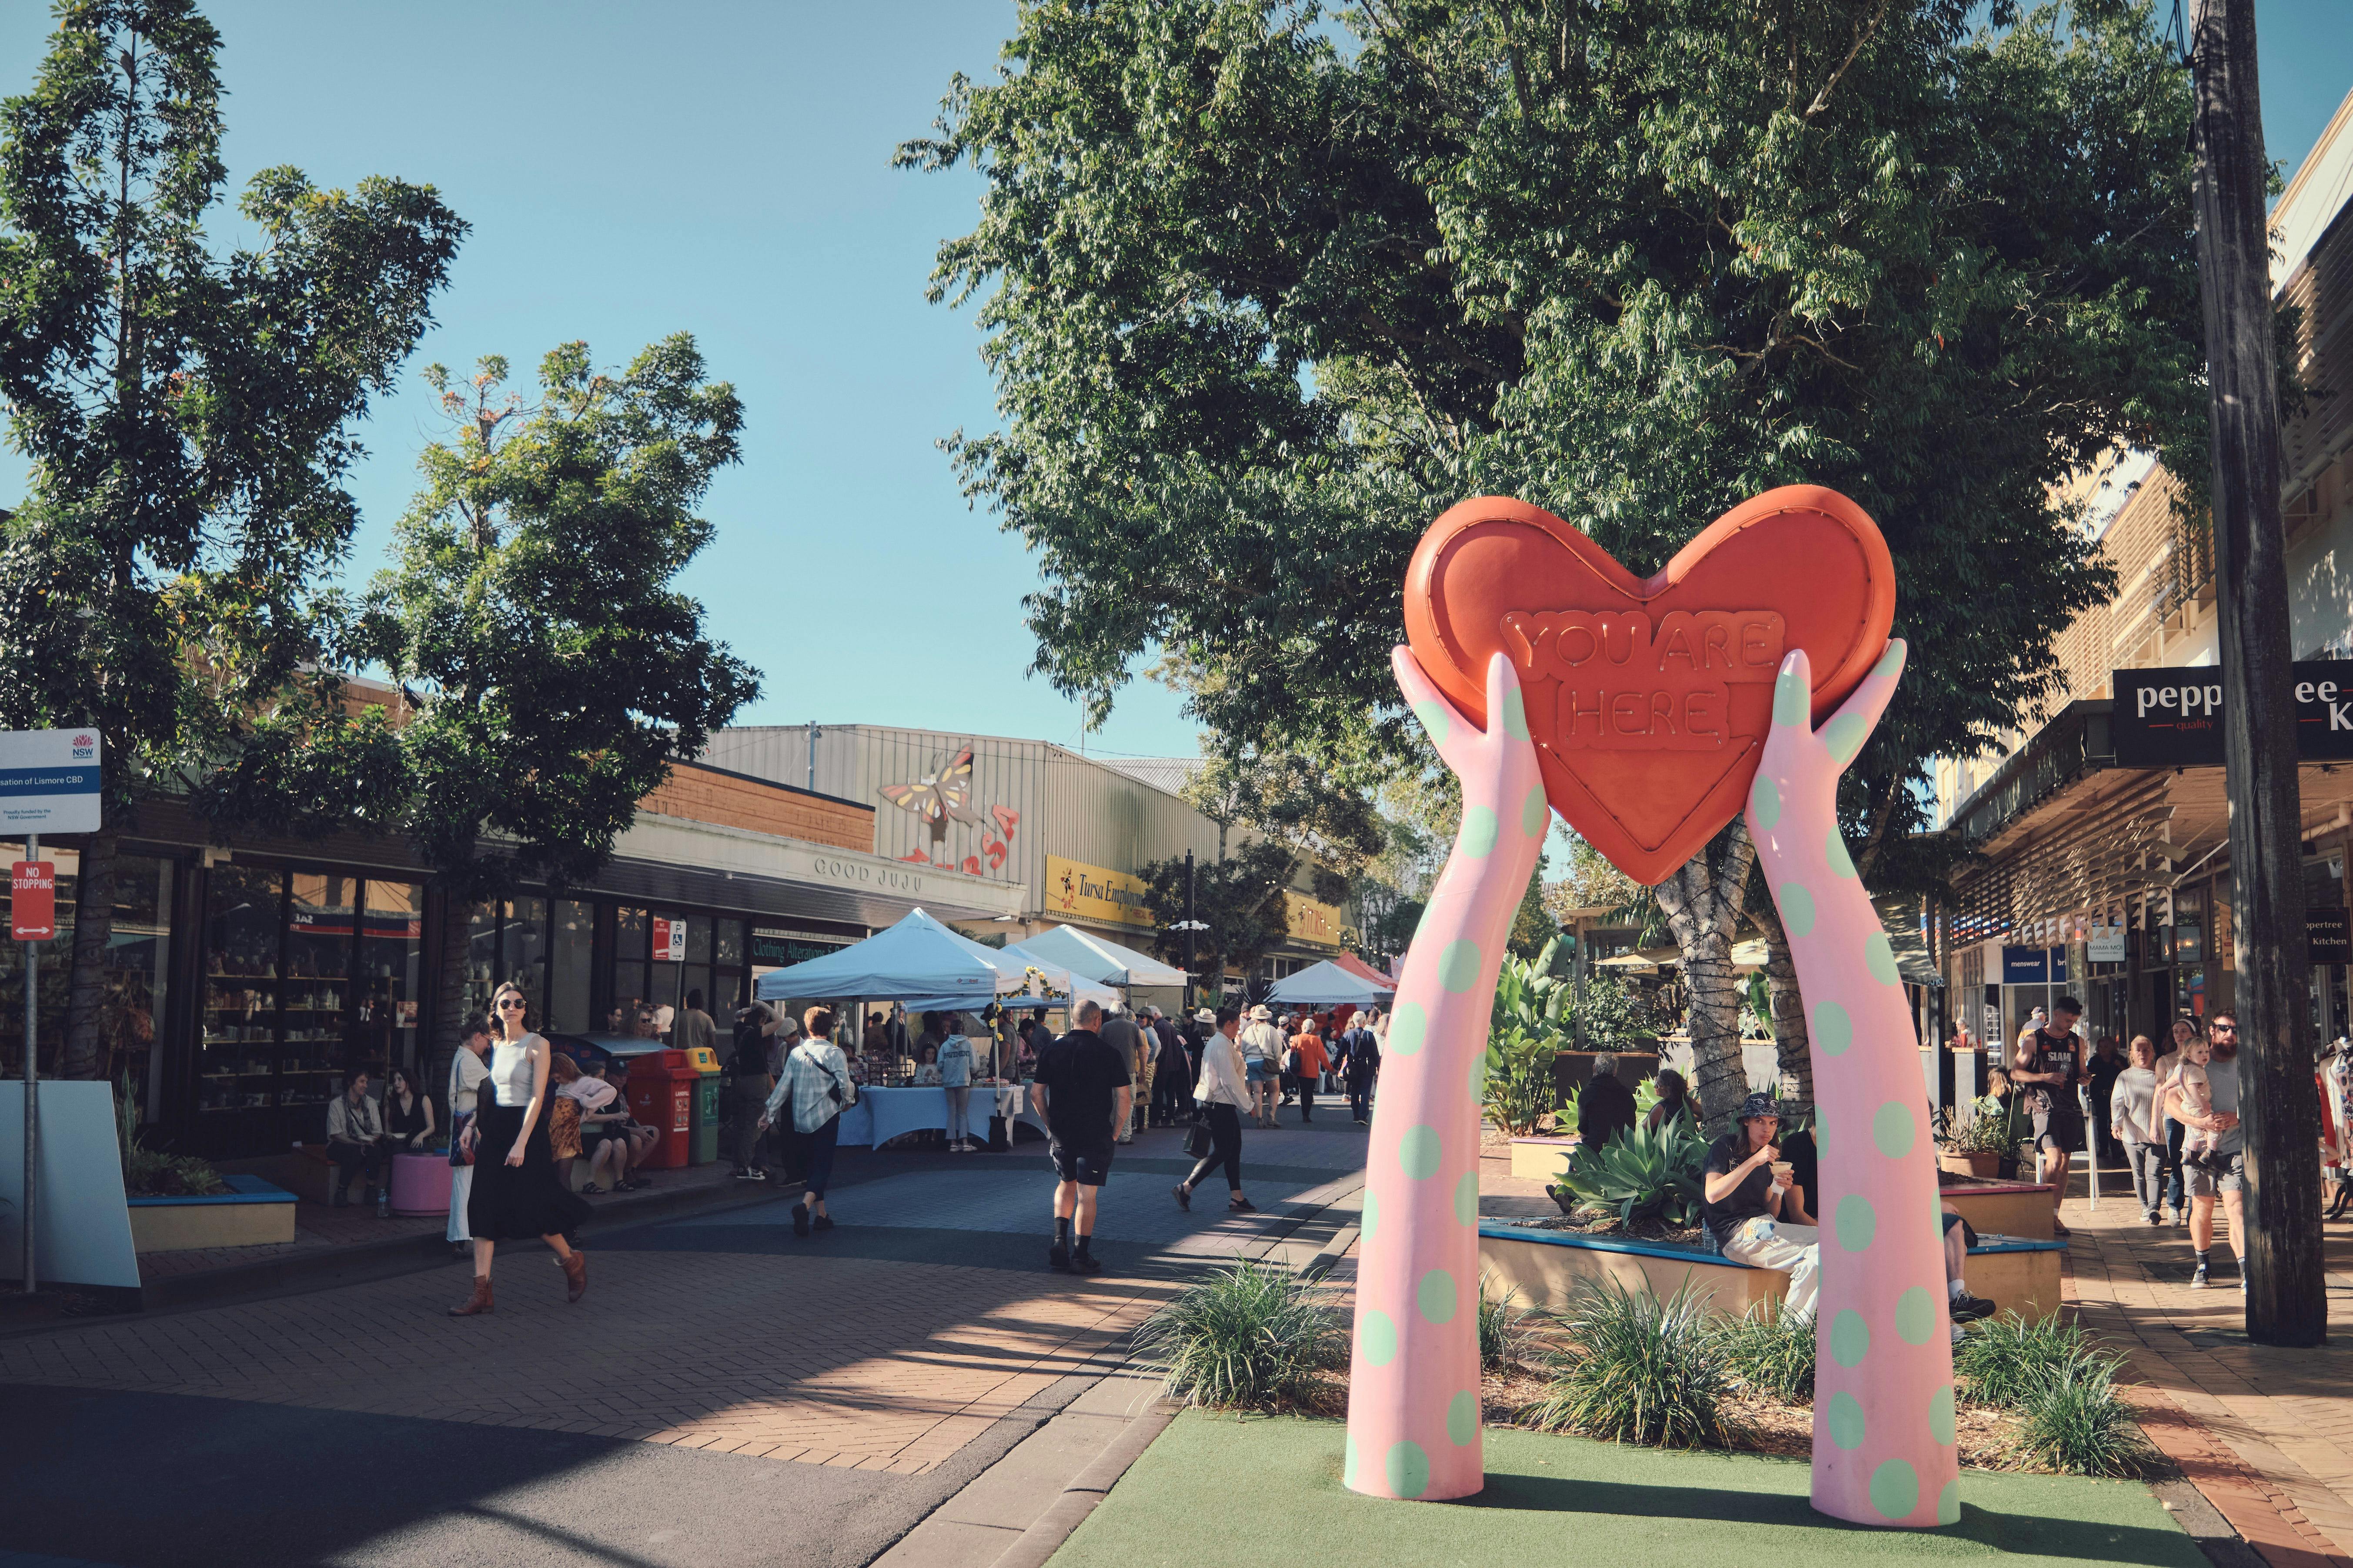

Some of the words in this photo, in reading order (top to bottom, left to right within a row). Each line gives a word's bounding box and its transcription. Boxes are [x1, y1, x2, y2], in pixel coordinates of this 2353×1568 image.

[1515, 623, 1636, 667] YOU
[1659, 624, 1773, 672] ARE
[1571, 690, 1720, 736] HERE
[2176, 719, 2213, 731] quality
[25, 777, 33, 785] of
[26, 867, 40, 878] NO
[815, 857, 869, 881] GOOD
[879, 870, 921, 892] JUJU
[13, 878, 53, 889] STOPPING
[1079, 874, 1104, 900] Tursa
[1105, 880, 1143, 912] Employm
[2313, 937, 2347, 945] Kitchen
[753, 938, 785, 963] Clothing
[786, 941, 825, 960] Alterations
[2048, 1051, 2072, 1062] SLAM
